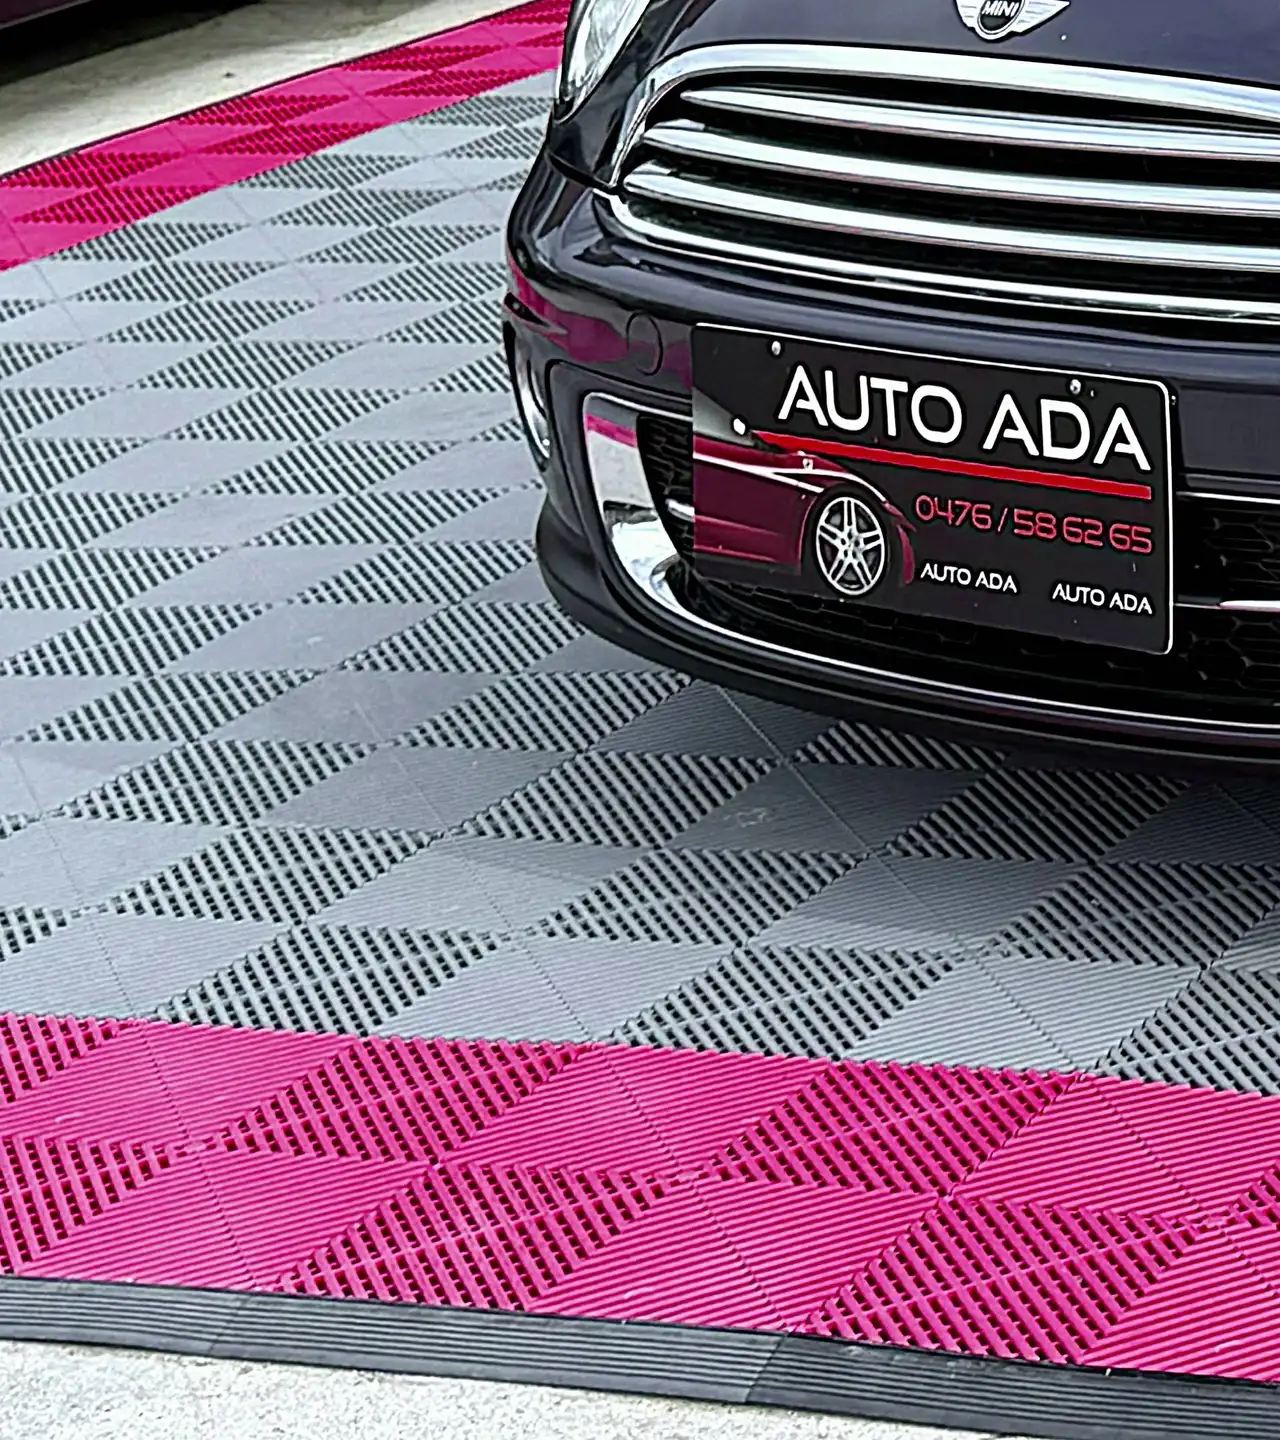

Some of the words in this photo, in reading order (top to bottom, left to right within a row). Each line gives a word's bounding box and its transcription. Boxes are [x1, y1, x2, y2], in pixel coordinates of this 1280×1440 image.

[981, 0, 1020, 17] MINI
[778, 365, 963, 444] AUTO
[983, 393, 1152, 471] ADA
[915, 494, 991, 529] 0476
[1013, 509, 1057, 540] 58
[1062, 516, 1103, 546] 62
[1108, 523, 1153, 554] 65
[920, 562, 972, 587] AUTO
[975, 569, 1017, 594] ADA
[1052, 583, 1105, 607] AUTO
[1109, 590, 1153, 616] ADA
